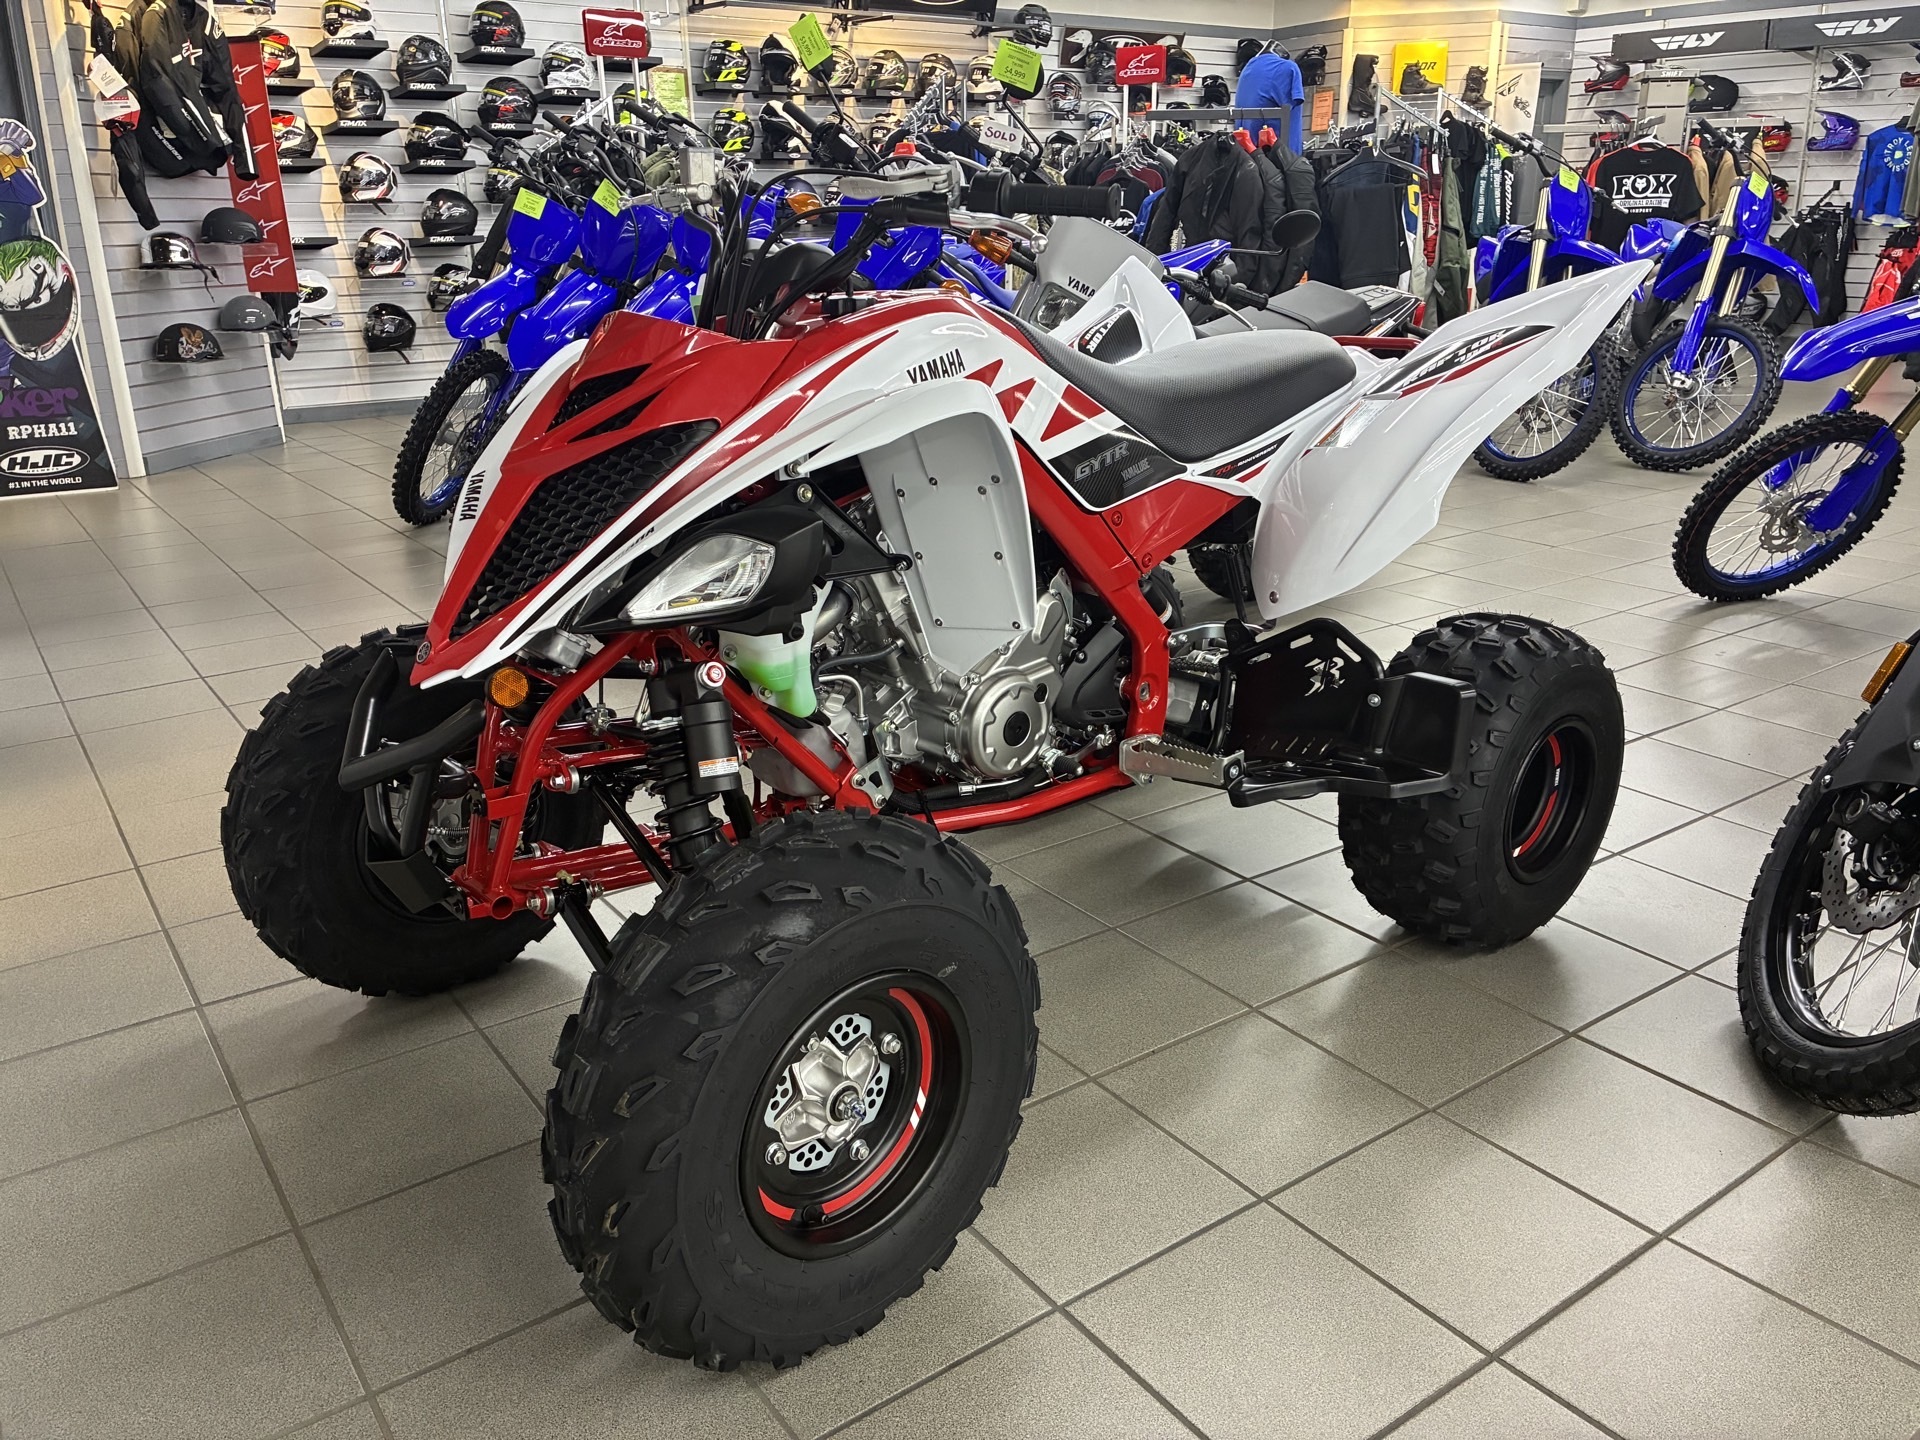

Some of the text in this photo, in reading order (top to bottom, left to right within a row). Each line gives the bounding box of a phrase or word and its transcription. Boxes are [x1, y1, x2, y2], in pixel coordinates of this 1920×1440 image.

[1815, 16, 1902, 37] FLY
[328, 38, 356, 46] GMAX
[481, 45, 506, 53] GMAX
[1651, 31, 1725, 50] FLY
[1004, 66, 1026, 80] $4,999
[409, 82, 436, 90] GMAX
[490, 122, 515, 130] GMAX
[984, 126, 1017, 142] SOLD
[151, 126, 183, 161] alpinestars
[1884, 137, 1903, 154] TROY
[1904, 140, 1914, 156] LEE
[1612, 174, 1678, 199] FOX
[429, 235, 455, 243] GMAX
[906, 348, 966, 384] YAMAHA
[6, 422, 78, 440] RPHA11
[6, 452, 76, 472] HJC
[1074, 440, 1130, 482] GYTR
[1237, 443, 1278, 467] ANNIVERSARY
[1120, 457, 1151, 481] YAMALUBE
[8, 476, 82, 489] #1 IN THE WORLD
[459, 470, 486, 521] YAMAHA
